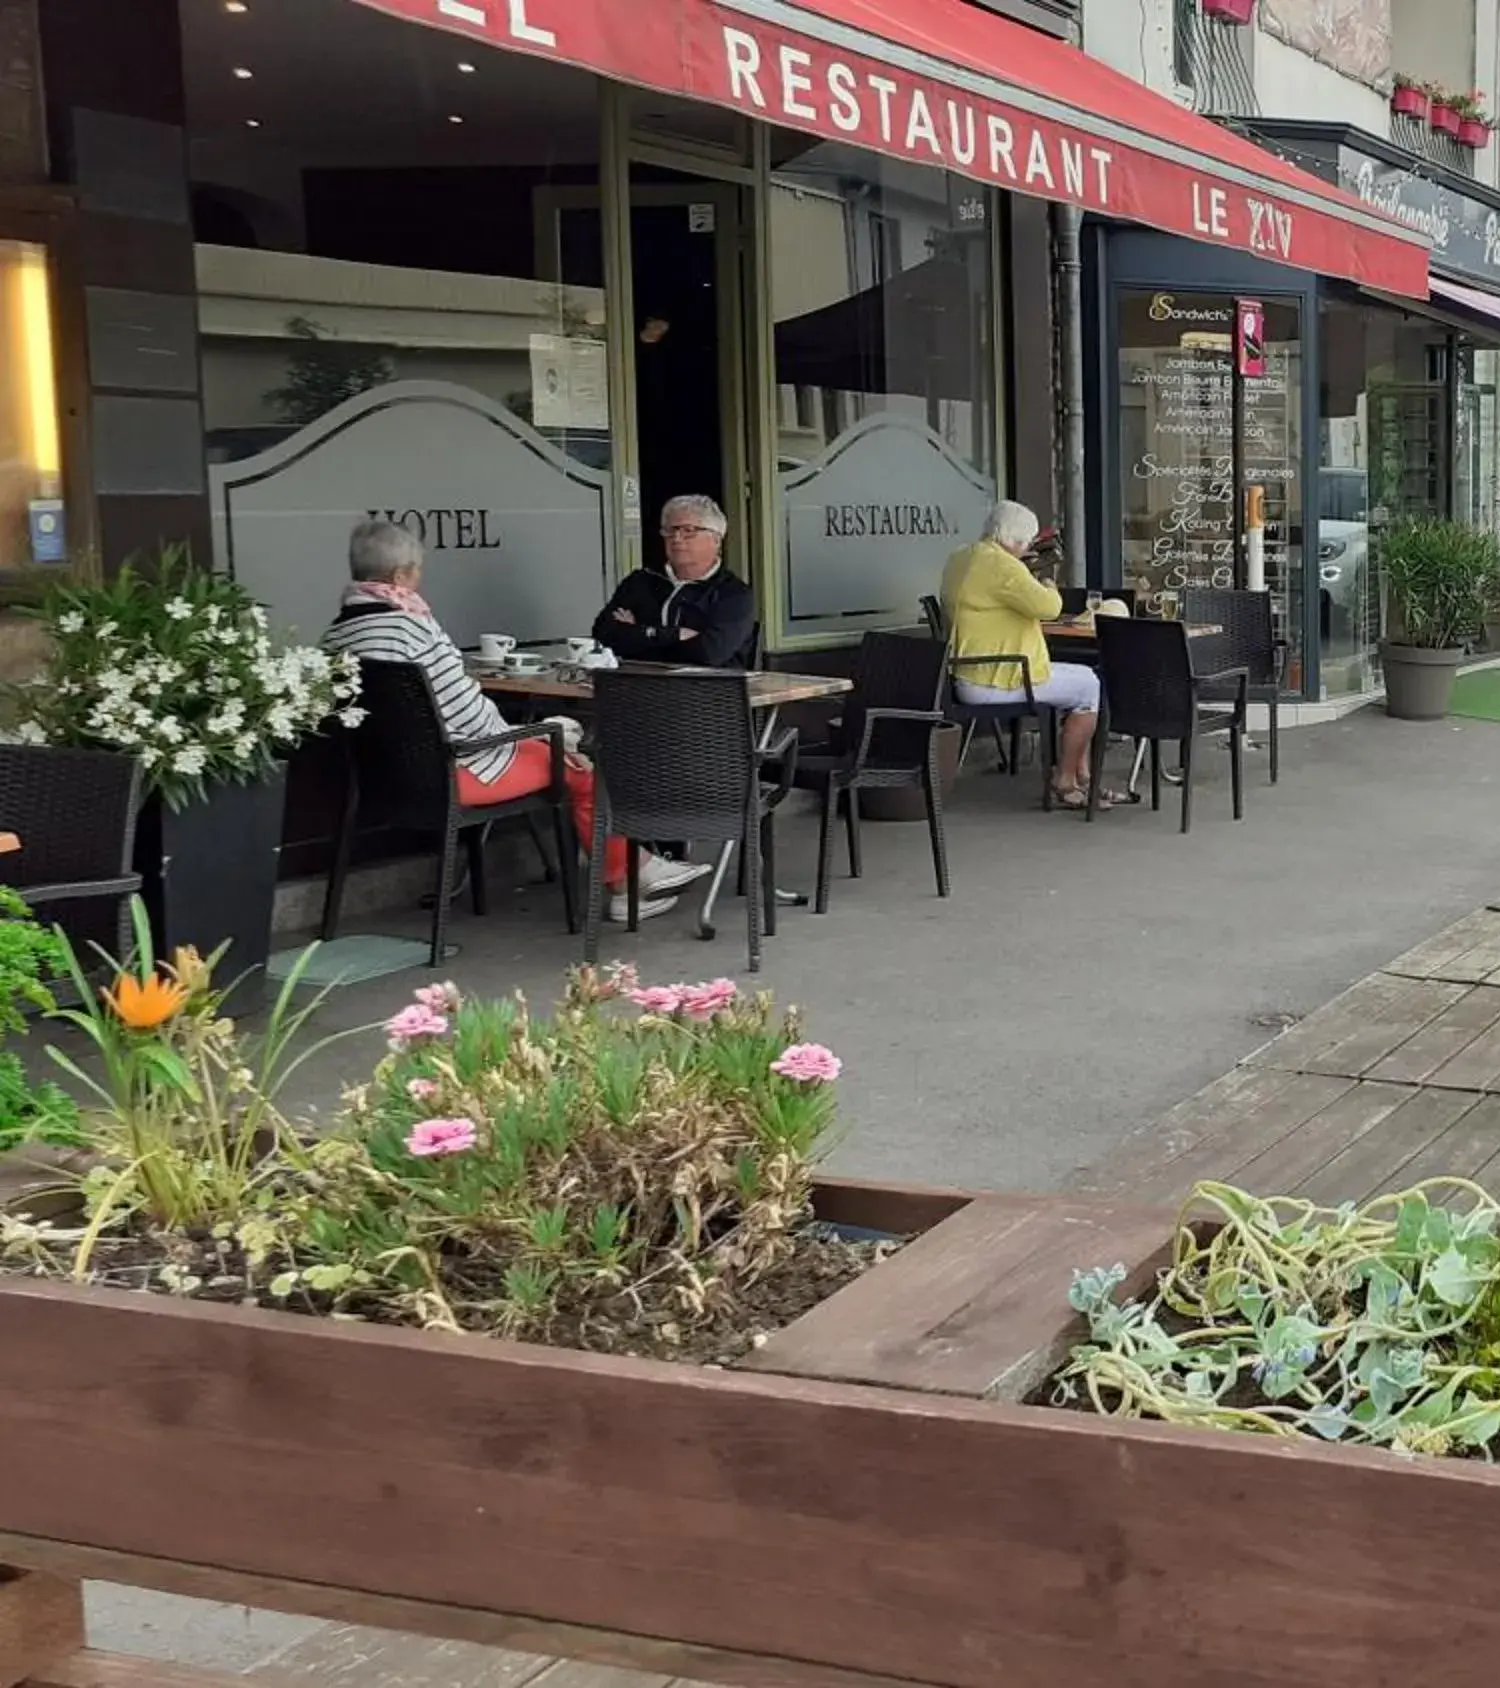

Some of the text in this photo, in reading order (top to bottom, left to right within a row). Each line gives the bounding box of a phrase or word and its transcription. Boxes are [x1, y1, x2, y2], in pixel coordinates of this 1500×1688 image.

[723, 26, 1112, 204] RESTAURANT
[1192, 181, 1229, 237] LE
[1247, 198, 1293, 258] XIV
